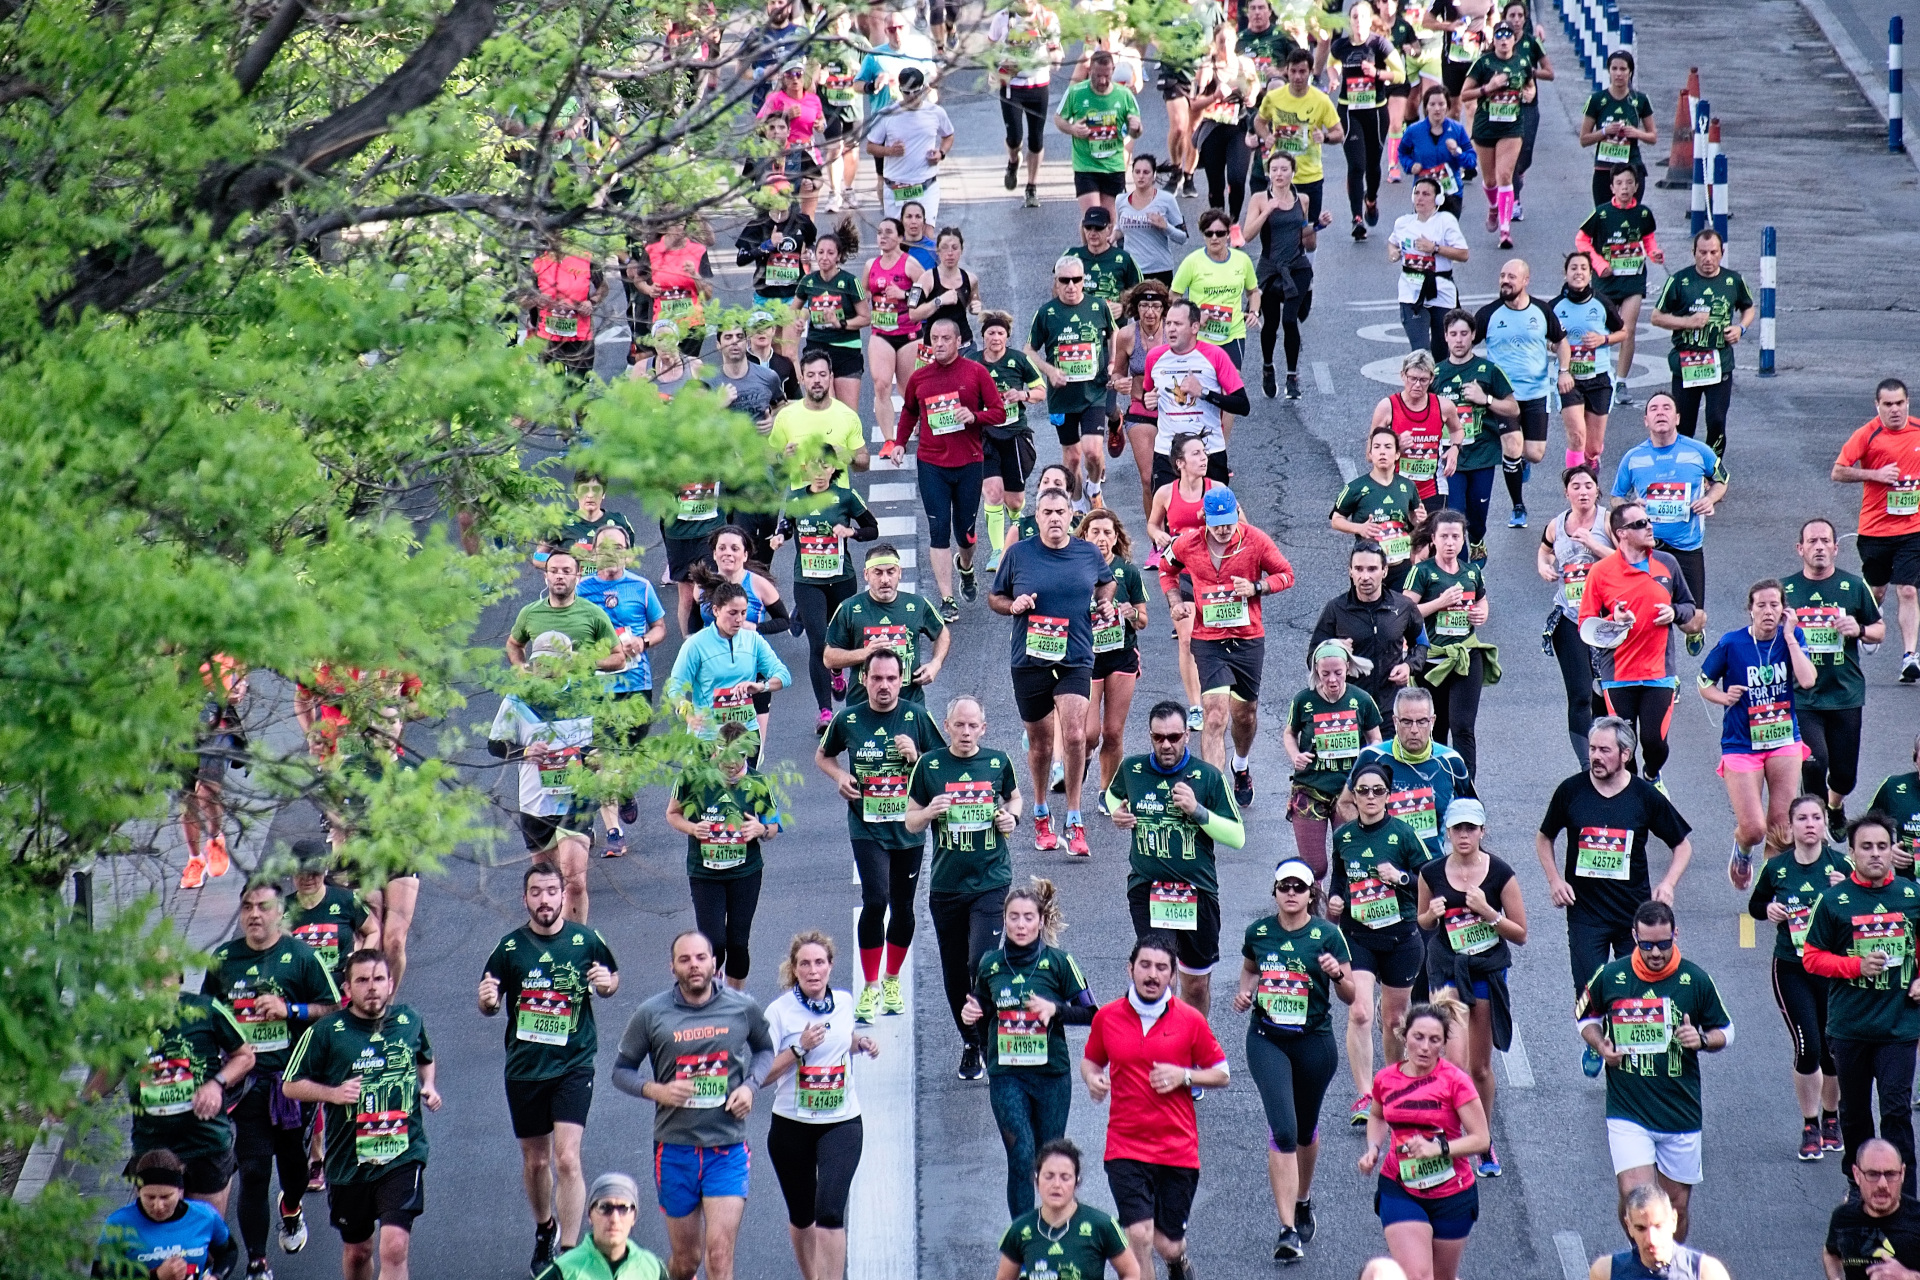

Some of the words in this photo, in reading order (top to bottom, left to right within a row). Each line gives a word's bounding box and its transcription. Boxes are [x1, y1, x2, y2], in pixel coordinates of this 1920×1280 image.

[1411, 435, 1439, 443] NMARK
[813, 559, 832, 569] 41915
[1215, 607, 1237, 618] 43163
[1810, 632, 1832, 644] 42954
[1749, 686, 1768, 700] FOR
[1770, 682, 1788, 696] THE
[1765, 727, 1787, 739] 41624
[1330, 736, 1351, 748] 40676
[856, 750, 884, 758] MADRID
[1145, 792, 1156, 801] edp
[877, 801, 900, 814] 42804
[1136, 802, 1164, 811] MADRID
[961, 809, 985, 821] 41756
[1592, 855, 1616, 869] 42572
[1164, 908, 1188, 919] 41644
[1361, 909, 1366, 921] F
[1366, 906, 1390, 920] 40694
[1460, 934, 1466, 947] F
[1466, 926, 1489, 943] 40897
[529, 968, 543, 979] edp
[521, 979, 551, 990] MADRID
[1272, 1001, 1298, 1013] 40834
[533, 1018, 560, 1033] 42859
[252, 1027, 278, 1041] 42384
[1630, 1029, 1656, 1043] 42659
[1013, 1041, 1038, 1053] 41987
[352, 1058, 385, 1071] MADRID
[159, 1087, 185, 1104] 40821
[807, 1095, 813, 1109] F
[814, 1095, 838, 1108] 41439
[373, 1140, 399, 1153] 41500
[1410, 1165, 1417, 1179] F
[1417, 1158, 1444, 1176] 40951
